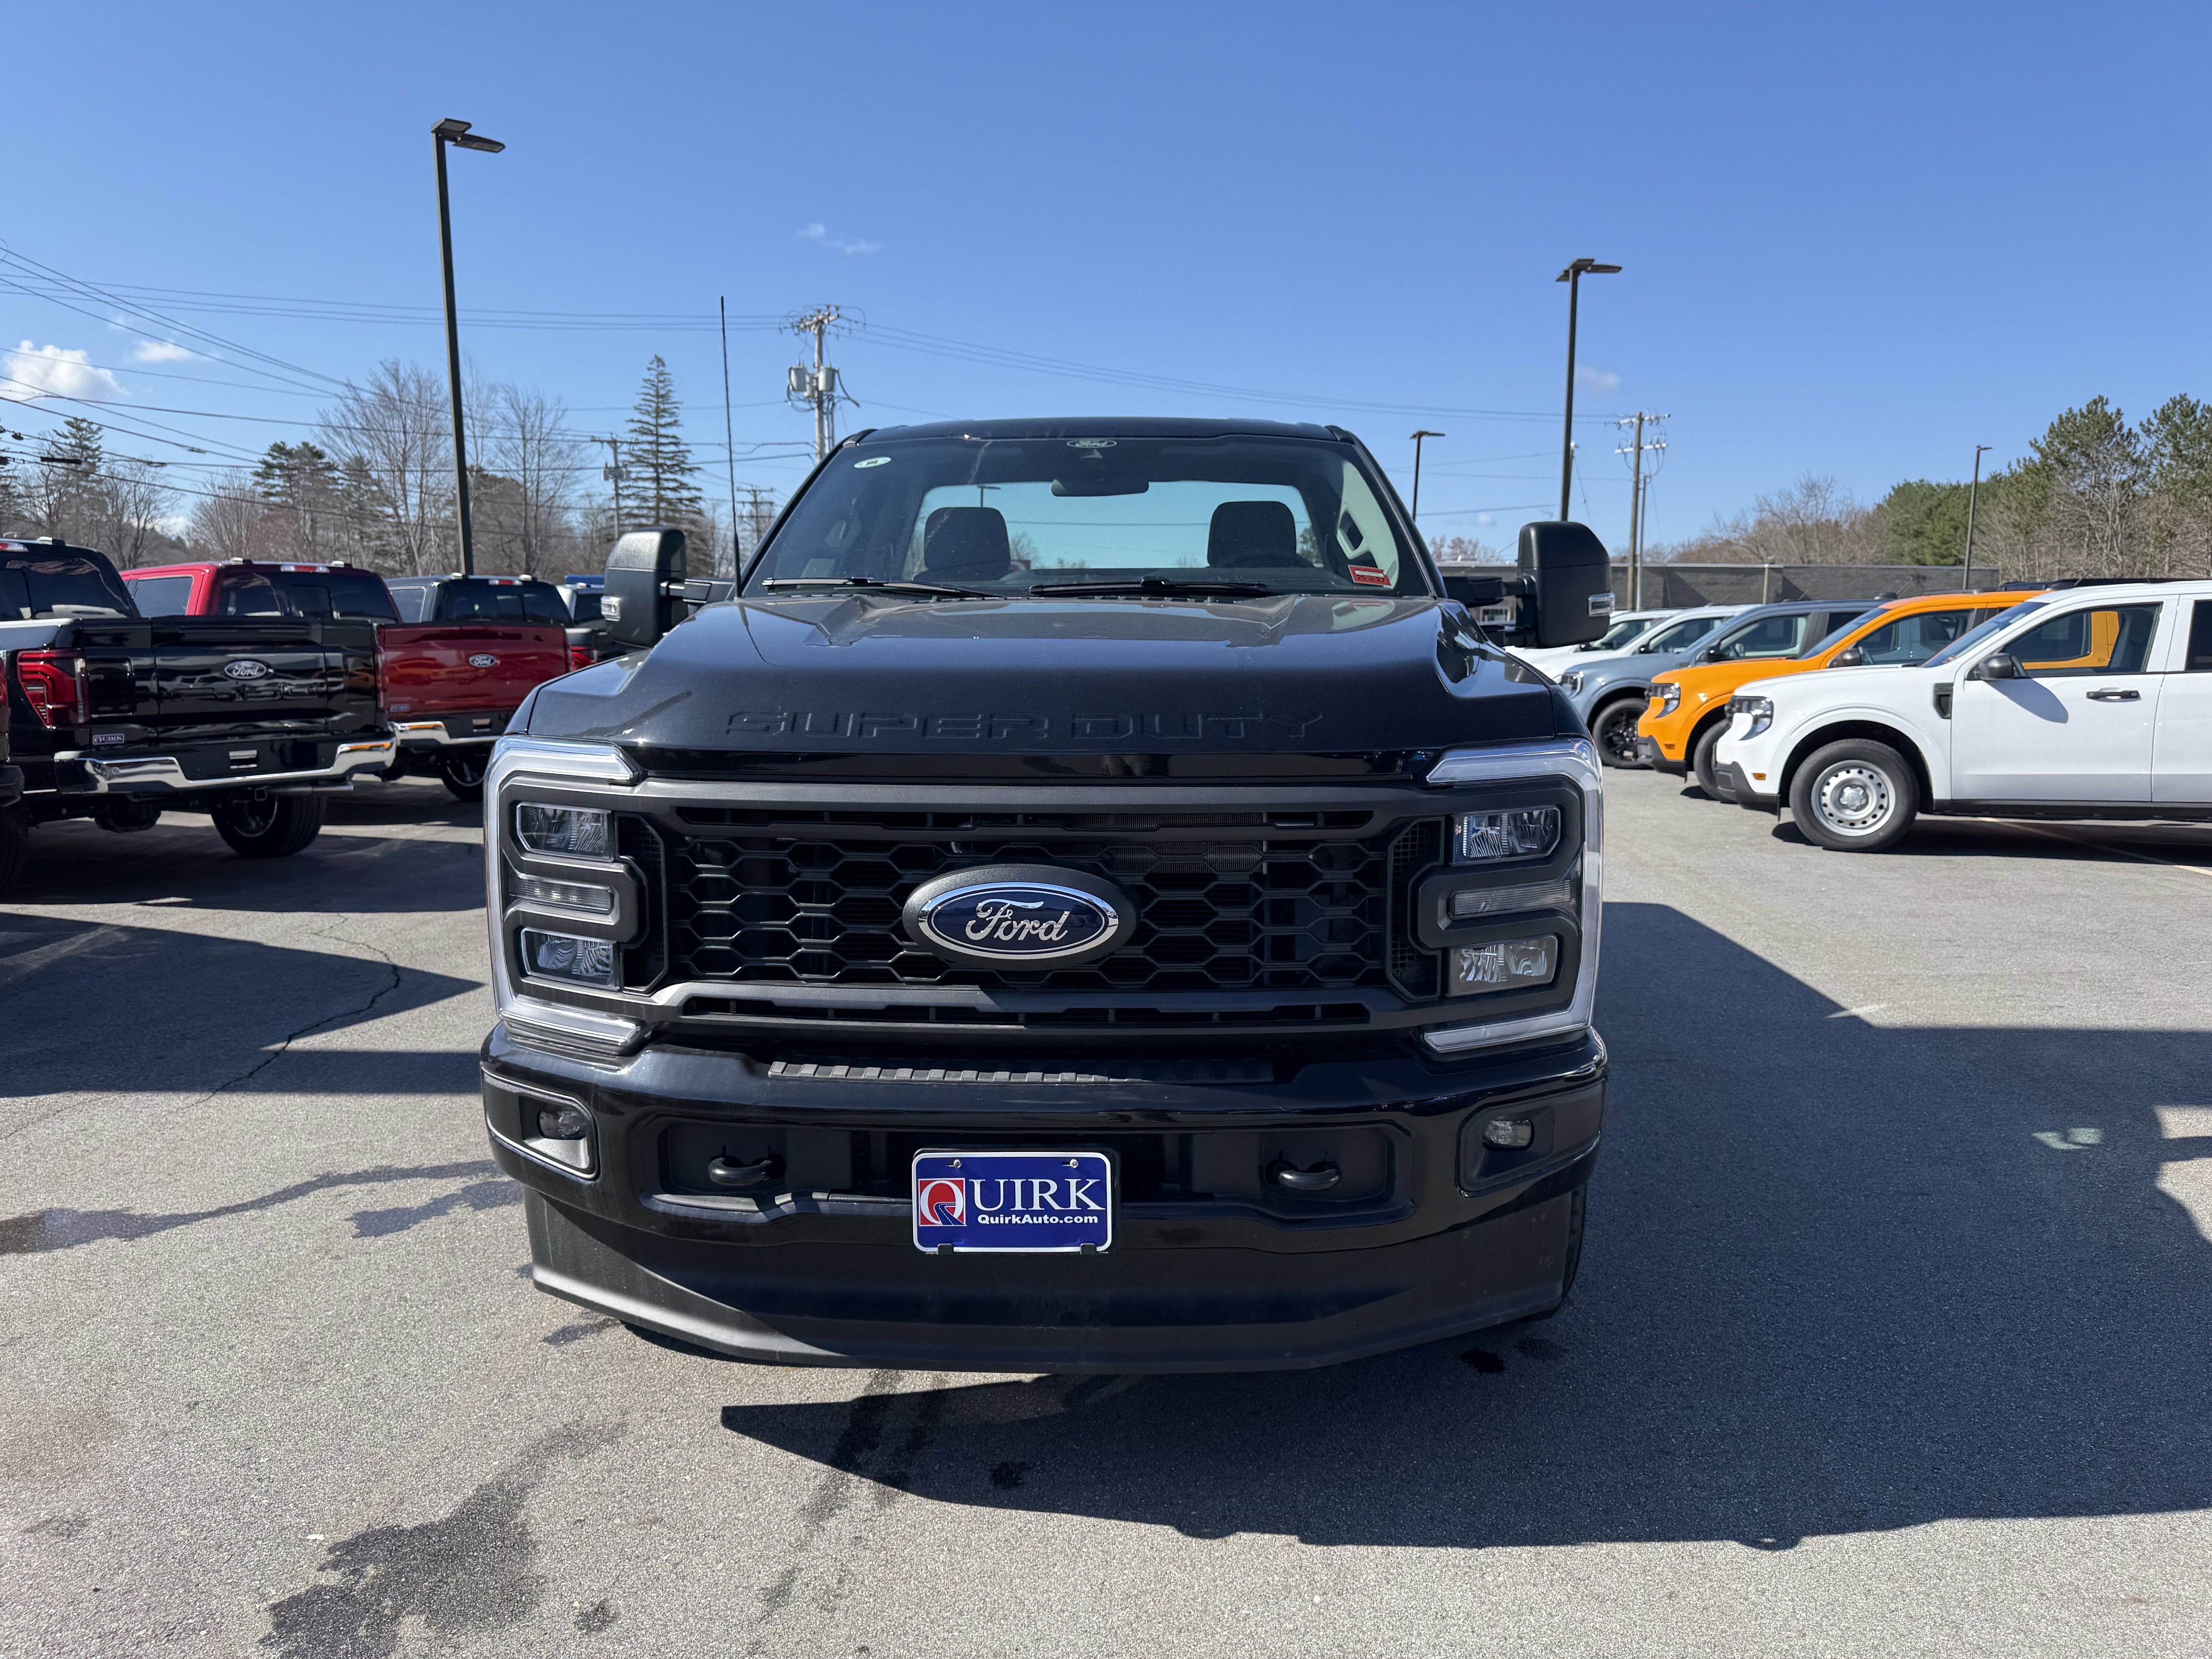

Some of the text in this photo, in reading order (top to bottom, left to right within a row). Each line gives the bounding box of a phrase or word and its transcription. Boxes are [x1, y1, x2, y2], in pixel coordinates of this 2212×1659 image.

[233, 662, 259, 676] Ford
[726, 712, 1324, 739] SUPER DUTY
[965, 898, 1068, 941] Ford
[920, 1179, 1106, 1226] QUIRK
[977, 1214, 1098, 1224] QuirkAuto.com
